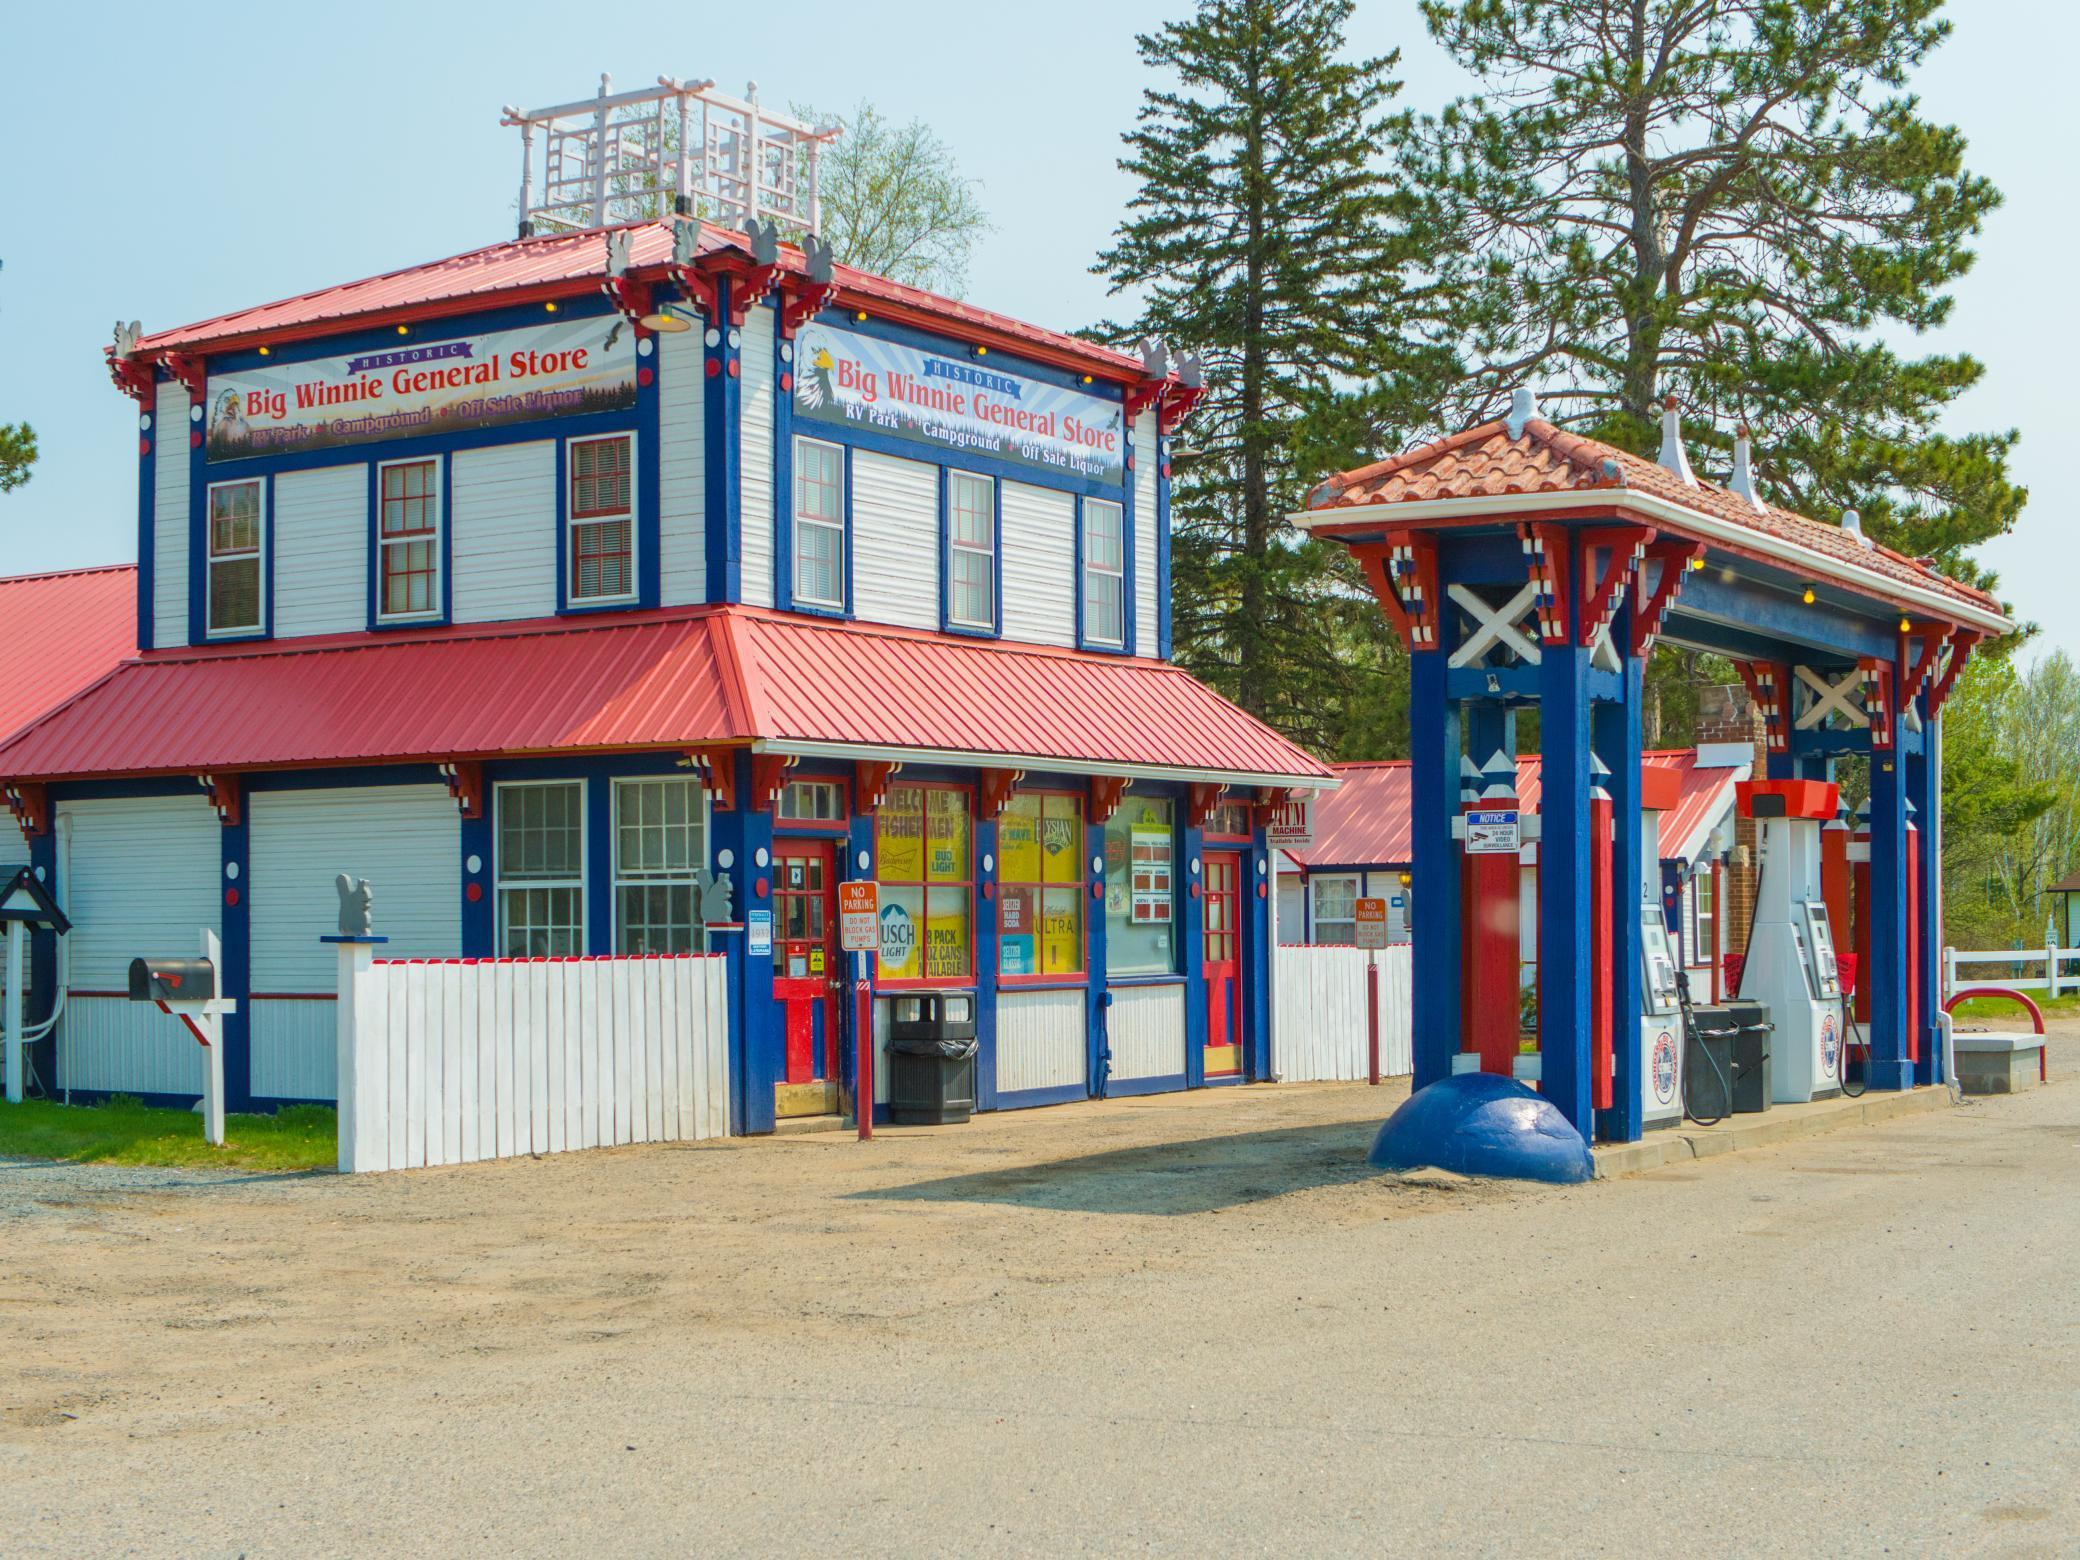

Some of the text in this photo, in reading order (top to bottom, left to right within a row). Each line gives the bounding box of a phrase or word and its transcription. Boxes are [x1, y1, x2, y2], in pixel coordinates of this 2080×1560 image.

[362, 344, 459, 369] HISTORIC
[247, 347, 589, 420] Big Winnie General Store
[933, 361, 1013, 393] HISTORIC
[837, 358, 1116, 451] Big Winnie General Store
[273, 426, 309, 444] Park
[332, 406, 431, 434] Campground
[458, 398, 484, 417] Off
[486, 394, 522, 414] Sale
[845, 404, 1105, 476] RV Park Campground Off Sale Liquor
[1479, 813, 1507, 823] NOTICE
[1272, 826, 1307, 835] MACHINE
[935, 850, 953, 861] BUD
[931, 861, 956, 872] LIGHT
[851, 886, 865, 898] NO
[844, 899, 874, 910] PARKING
[1364, 902, 1377, 910] NO
[1358, 911, 1383, 919] PARKING
[1003, 920, 1020, 928] SODA
[1035, 919, 1075, 934] ULTRA
[881, 924, 915, 945] USCH
[934, 930, 956, 945] PACK
[881, 946, 907, 957] LIGHT
[939, 946, 962, 961] CANS
